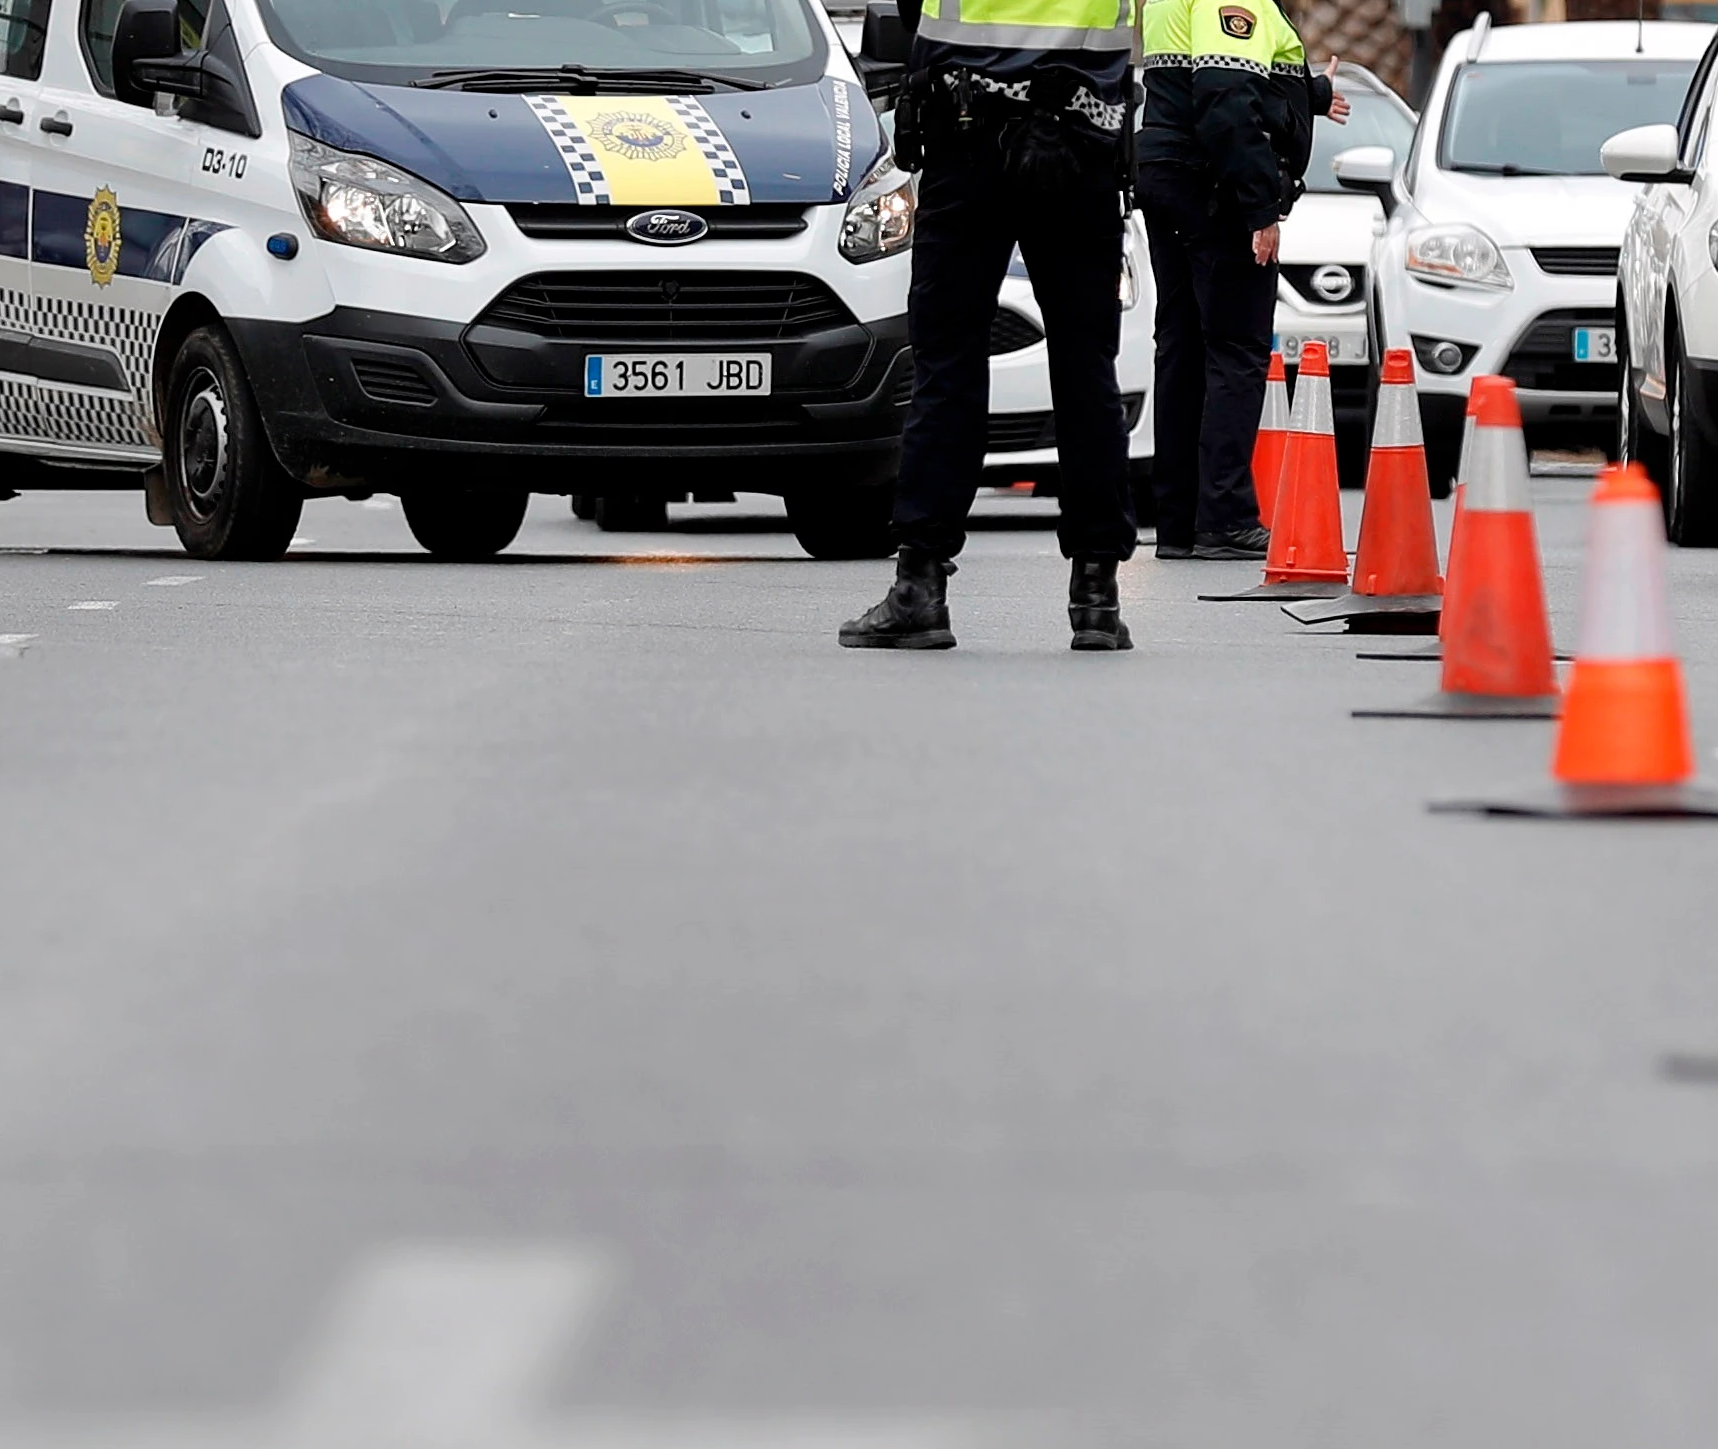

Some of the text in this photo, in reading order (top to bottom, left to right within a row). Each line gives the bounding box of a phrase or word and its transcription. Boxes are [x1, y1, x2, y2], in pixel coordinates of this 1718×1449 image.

[836, 121, 852, 150] LOCAL
[833, 150, 851, 196] POLICIA
[646, 214, 691, 234] Ford
[1285, 336, 1339, 358] 98
[612, 360, 684, 391] 3561
[706, 359, 764, 391] JBD
